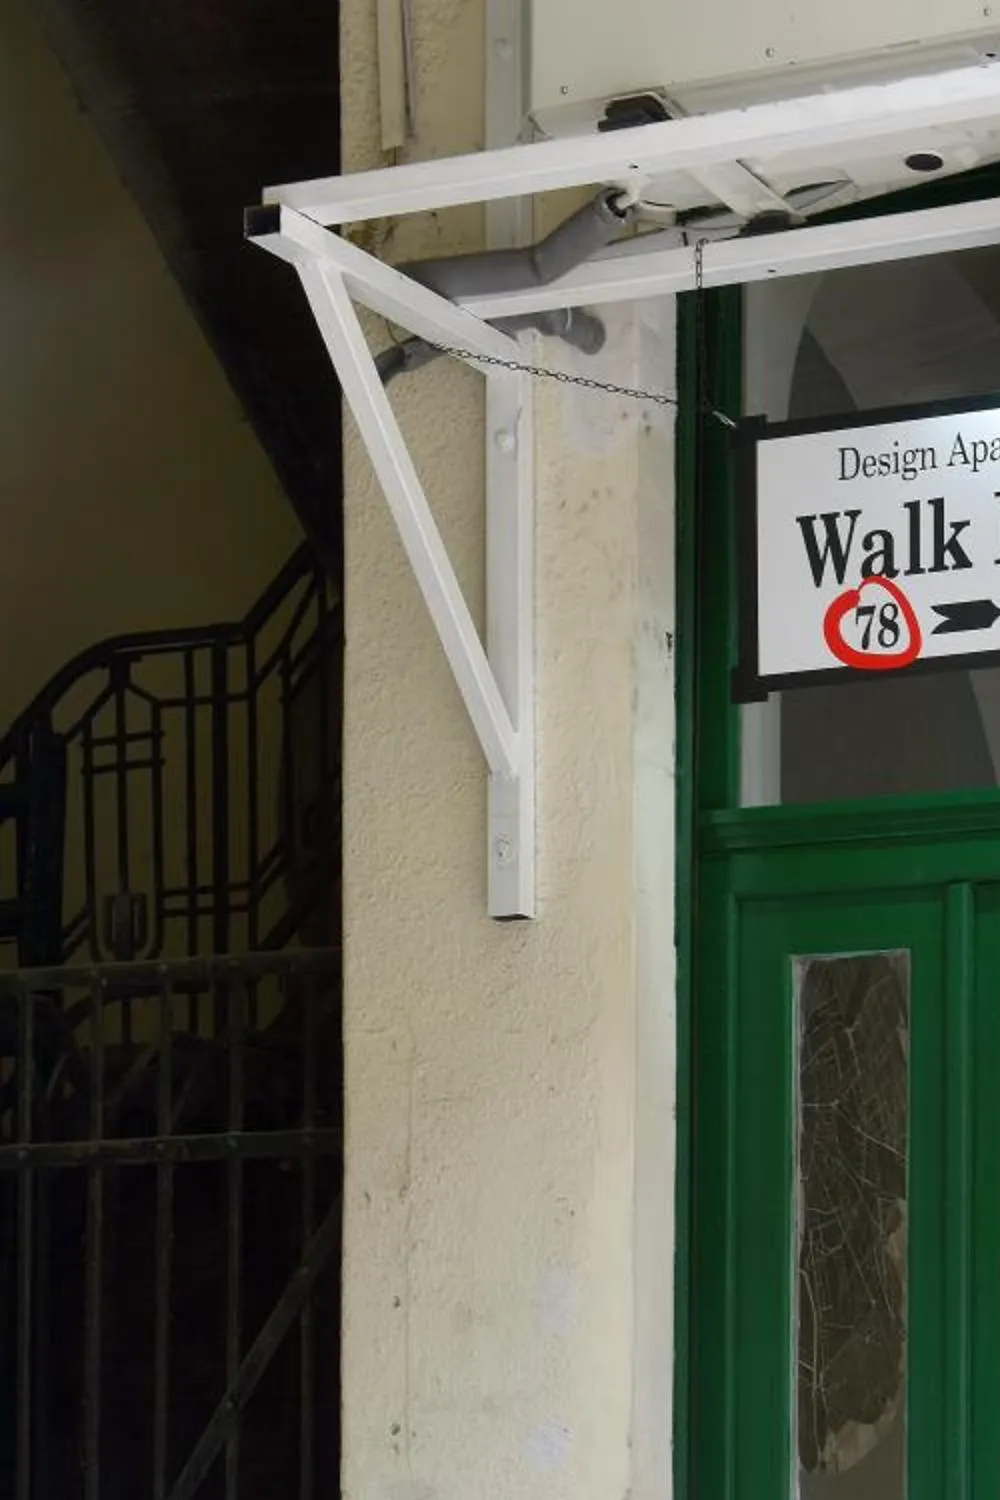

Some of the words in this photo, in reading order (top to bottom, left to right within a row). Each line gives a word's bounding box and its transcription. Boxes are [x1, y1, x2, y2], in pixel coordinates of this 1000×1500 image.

[838, 441, 937, 481] Design
[796, 497, 973, 588] Walk
[856, 603, 900, 651] 78
